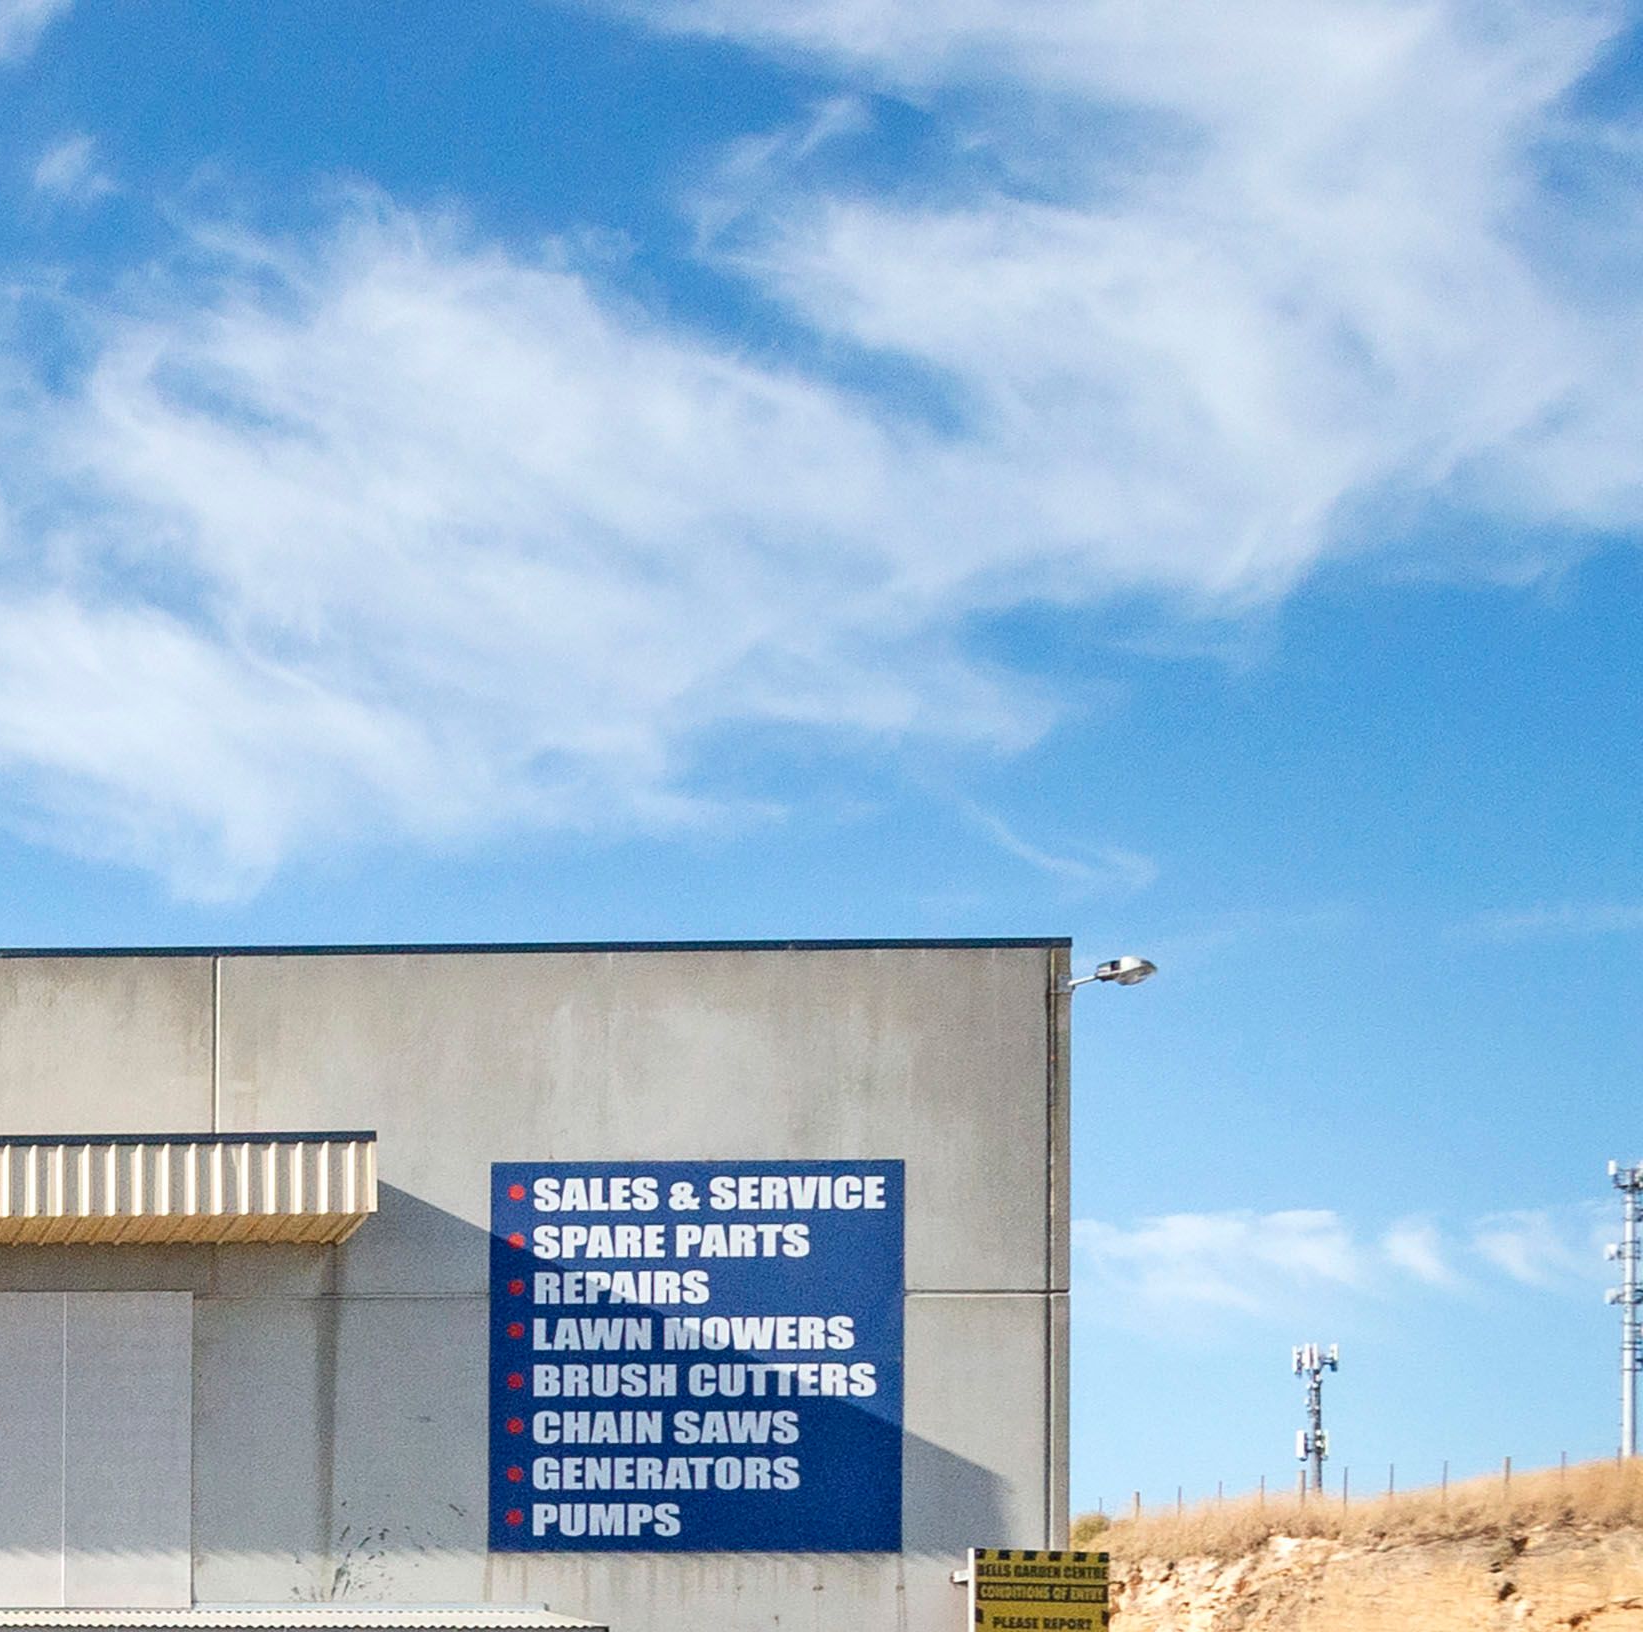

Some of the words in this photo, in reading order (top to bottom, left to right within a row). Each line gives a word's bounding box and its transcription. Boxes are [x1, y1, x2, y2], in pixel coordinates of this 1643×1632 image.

[533, 1177, 659, 1213] SALES
[668, 1181, 700, 1211] &
[709, 1175, 887, 1211] SERVICE
[533, 1224, 665, 1259] SPARE
[675, 1224, 810, 1258] PARTS
[533, 1270, 709, 1305] REPAIRS
[533, 1317, 654, 1351] LAWN
[664, 1316, 855, 1351] MOWERS
[533, 1364, 678, 1398] BRUSH
[688, 1363, 877, 1398] CUTTERS
[533, 1411, 663, 1445] CHAIN
[674, 1411, 800, 1445] SAWS
[532, 1457, 801, 1491] GENERATORS
[532, 1503, 681, 1537] PUMPS
[981, 1586, 1049, 1599] CONDITIONS
[1053, 1587, 1068, 1600] OF
[993, 1617, 1038, 1629] PLEASE
[1043, 1618, 1092, 1630] REPORT
